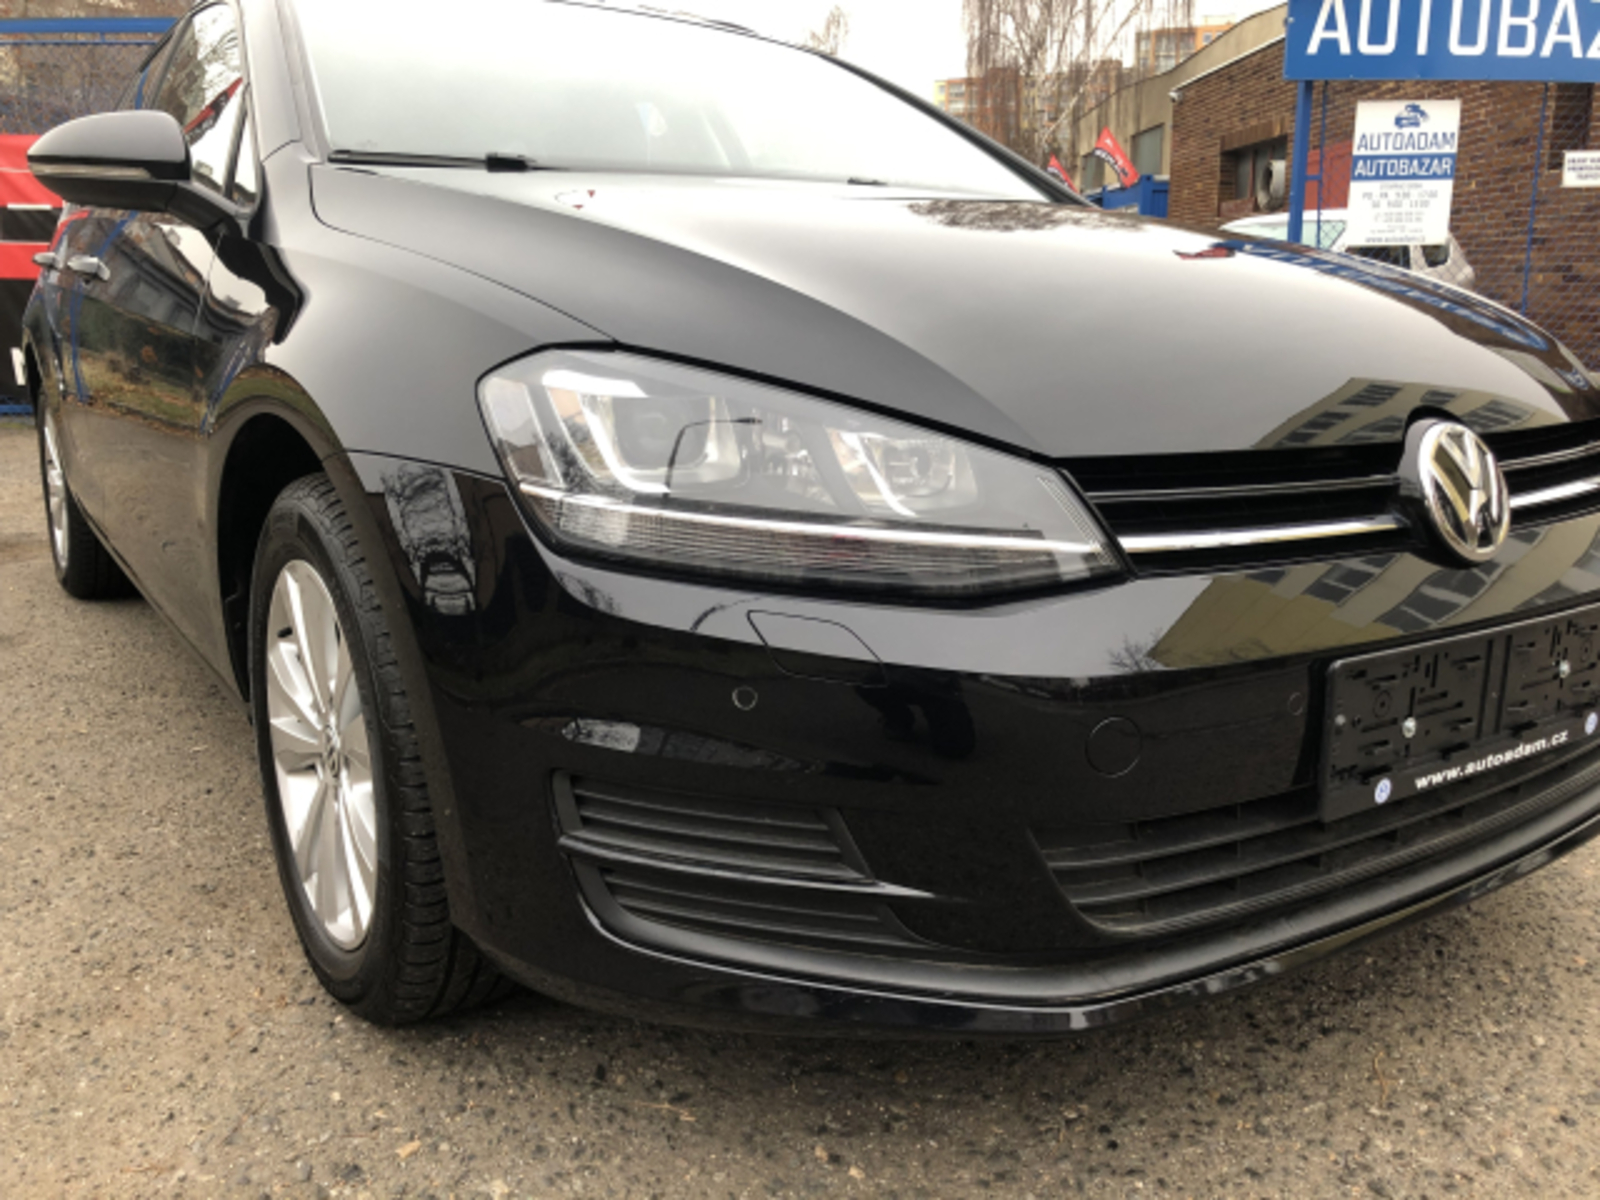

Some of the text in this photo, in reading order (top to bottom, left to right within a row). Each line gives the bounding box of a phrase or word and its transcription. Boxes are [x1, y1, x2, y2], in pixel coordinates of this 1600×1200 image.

[1357, 132, 1456, 152] AUTOADAM
[1354, 157, 1453, 177] AUTOBAZAR
[1414, 730, 1569, 790] www.autoadam.cz
